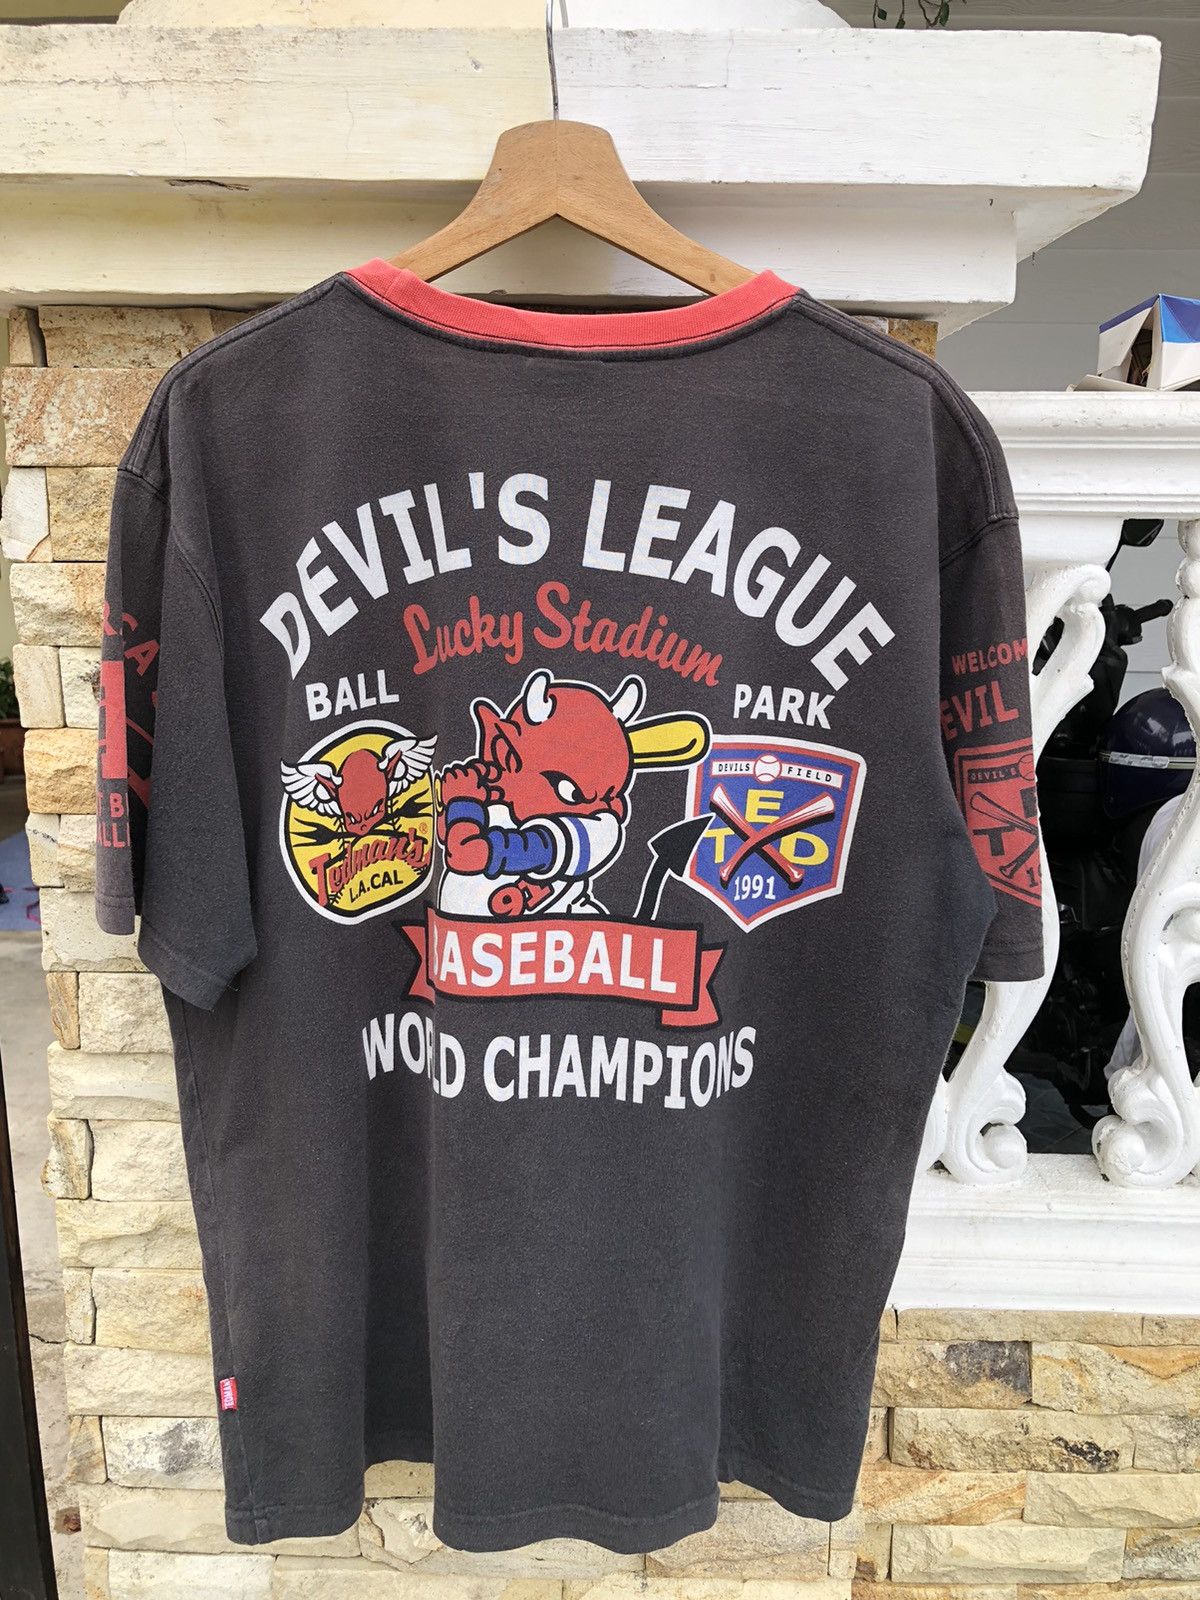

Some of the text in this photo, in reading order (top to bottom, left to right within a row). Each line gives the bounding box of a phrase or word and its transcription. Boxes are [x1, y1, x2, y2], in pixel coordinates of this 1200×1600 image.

[259, 472, 895, 691] DEVIL'S LEAGUE
[403, 581, 723, 687] Lucky Stadium
[305, 669, 400, 721] BALL
[733, 683, 835, 730] PARK
[718, 762, 832, 782] DEVILS FIELD
[491, 879, 551, 917] 91
[733, 874, 776, 901] 1991
[483, 1026, 757, 1110] CHAMPIONS
